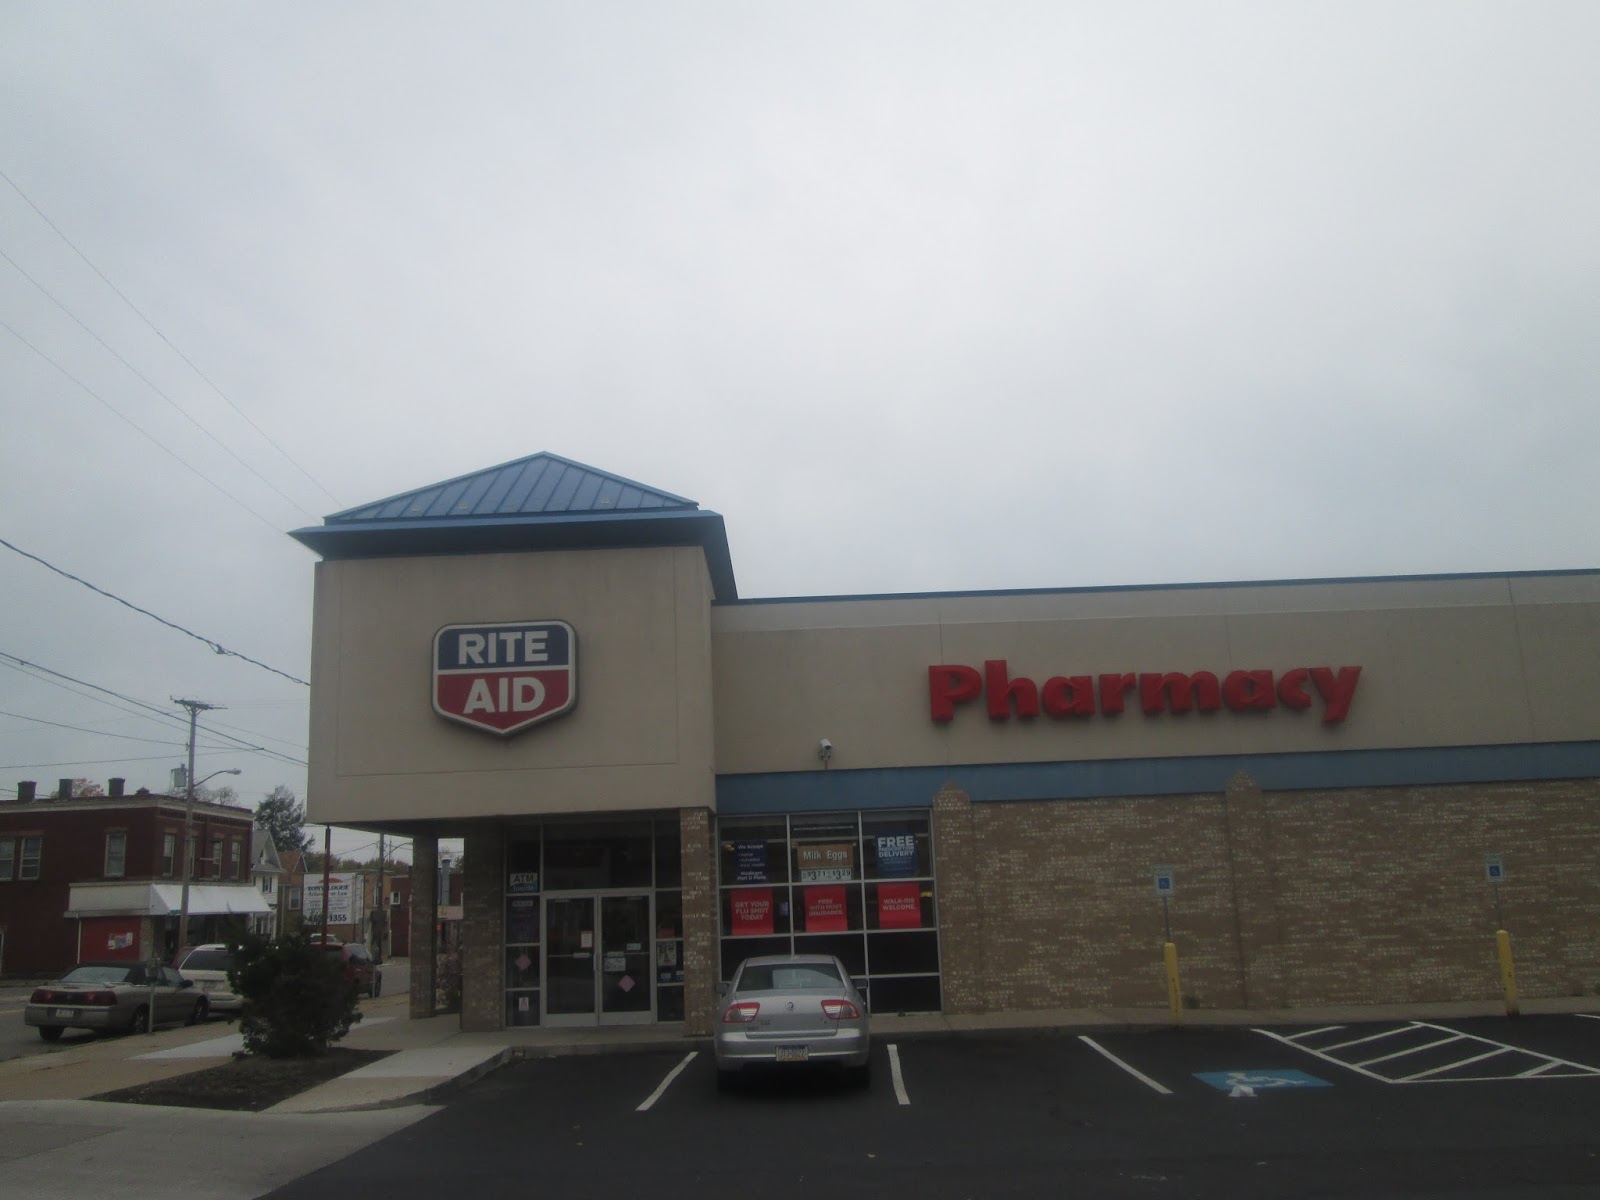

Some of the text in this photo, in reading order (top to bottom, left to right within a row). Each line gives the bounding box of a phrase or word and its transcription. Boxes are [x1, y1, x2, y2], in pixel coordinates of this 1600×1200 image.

[458, 630, 549, 665] RITE
[463, 677, 546, 714] AID
[928, 659, 1362, 722] Pharmacy
[878, 835, 914, 848] FREE
[803, 849, 848, 861] Milk Eggs
[878, 850, 914, 858] DELIVERY
[513, 874, 535, 883] ATM
[750, 900, 770, 908] YOUR
